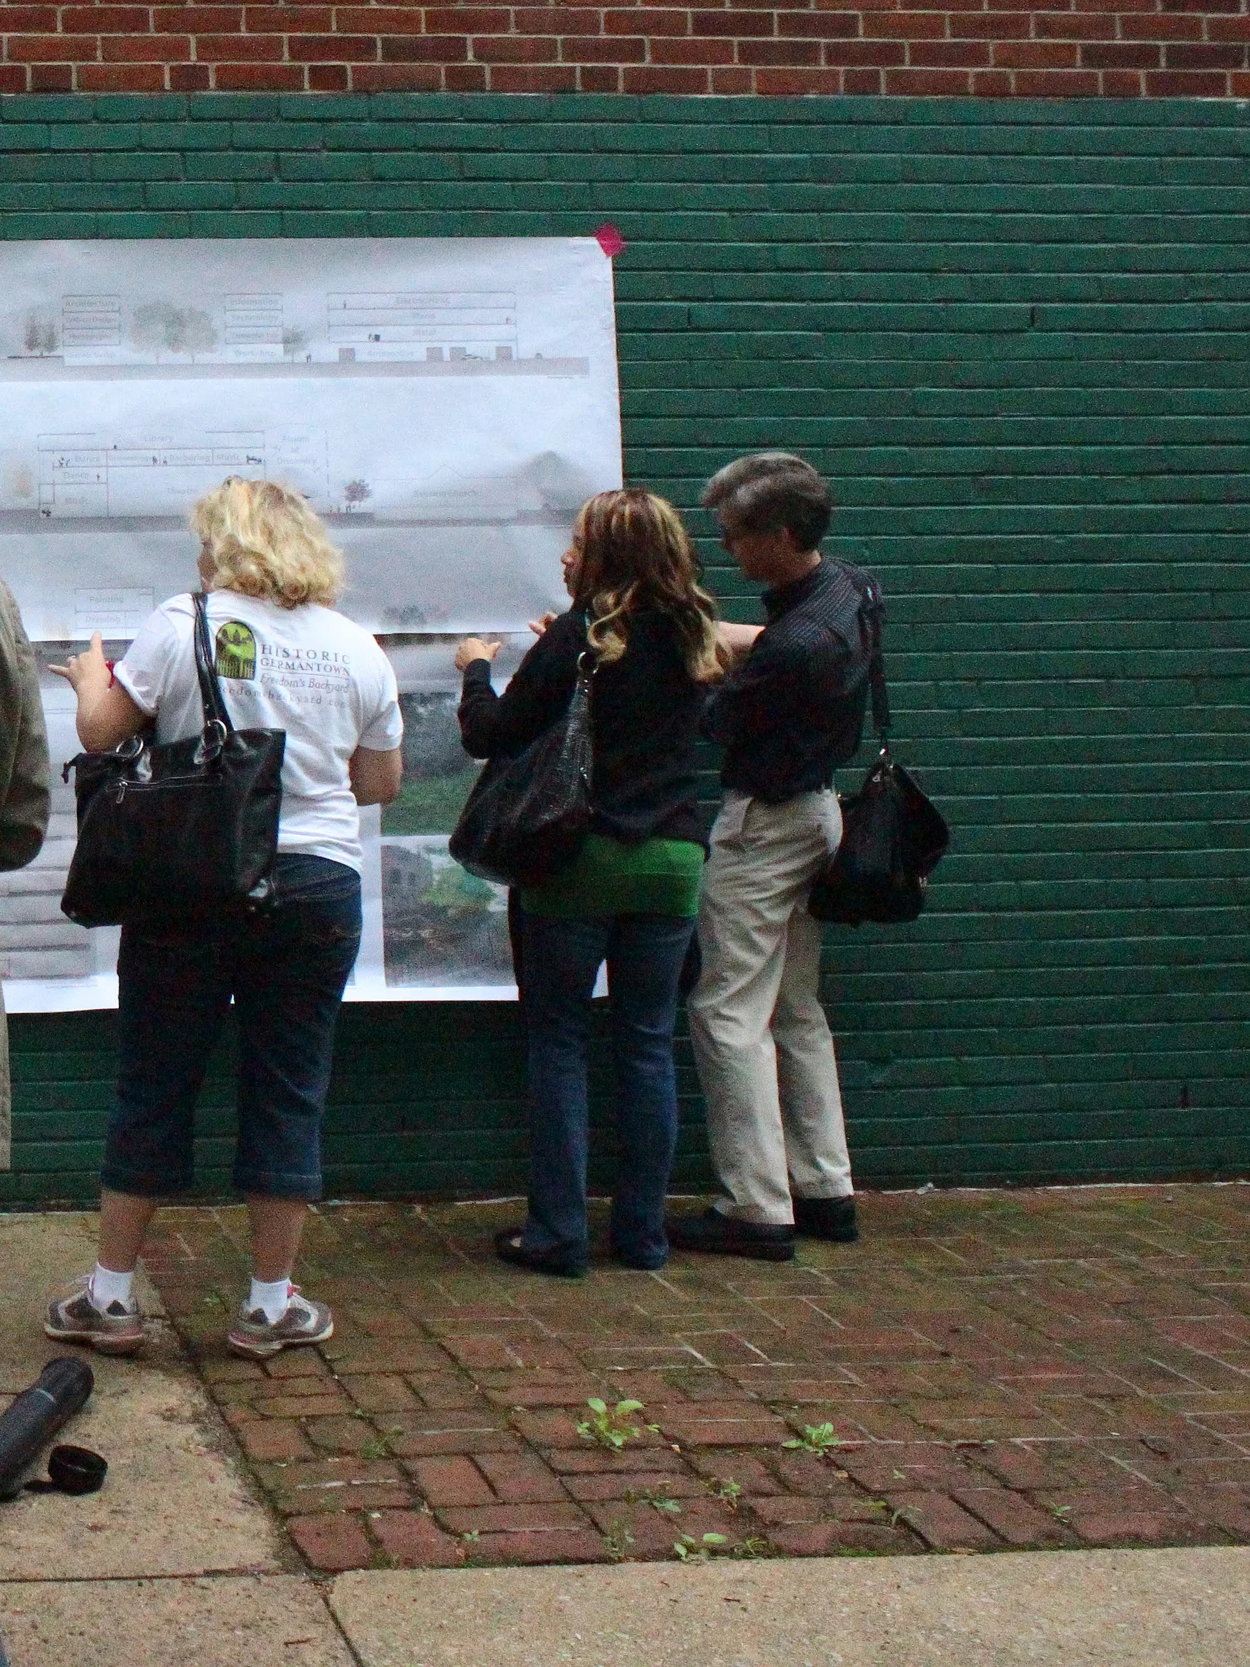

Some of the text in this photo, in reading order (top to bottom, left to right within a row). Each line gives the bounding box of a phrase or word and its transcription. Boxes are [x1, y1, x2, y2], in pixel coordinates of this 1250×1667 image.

[261, 644, 350, 664] HISTORIC
[260, 657, 351, 677] GERMANTOWN
[308, 678, 351, 694] Backyard
